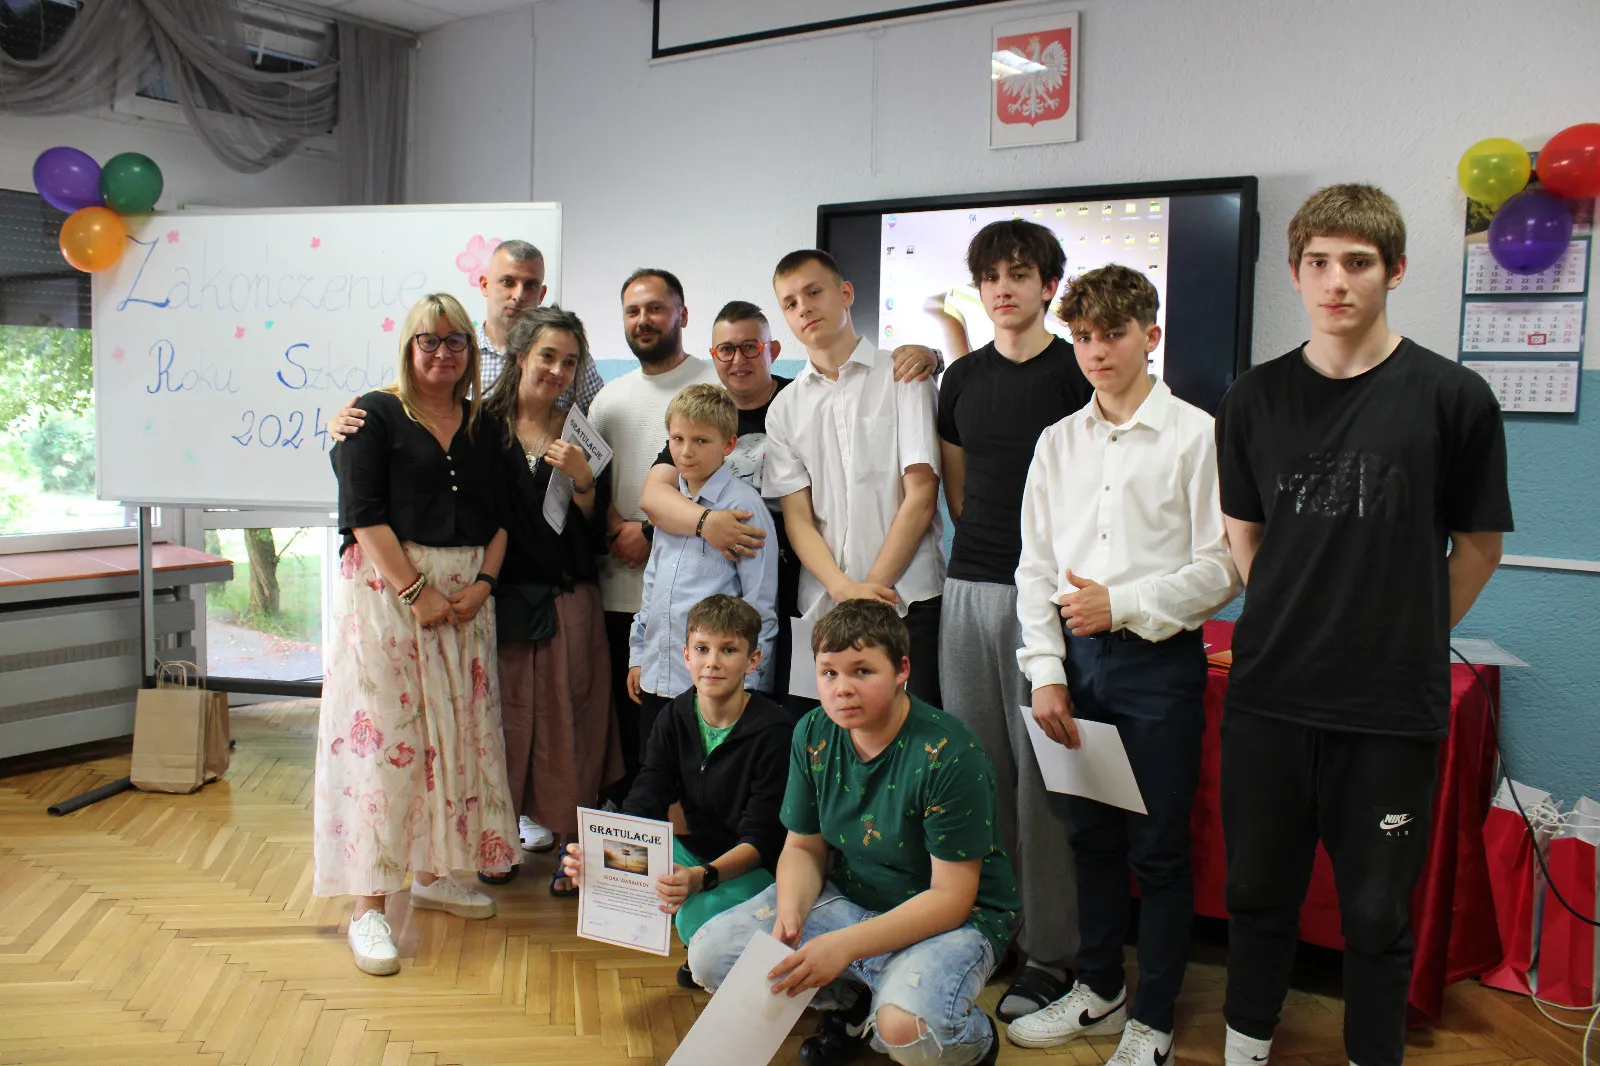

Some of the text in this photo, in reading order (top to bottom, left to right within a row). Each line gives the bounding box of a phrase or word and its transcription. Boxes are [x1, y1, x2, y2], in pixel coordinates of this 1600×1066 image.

[115, 234, 428, 313] Zakończenie
[144, 338, 395, 395] Roku Szkoln
[231, 407, 329, 451] 2024
[570, 418, 602, 460] GRATULACJE
[590, 824, 662, 844] GRATULACJE
[1384, 814, 1408, 824] NIKE
